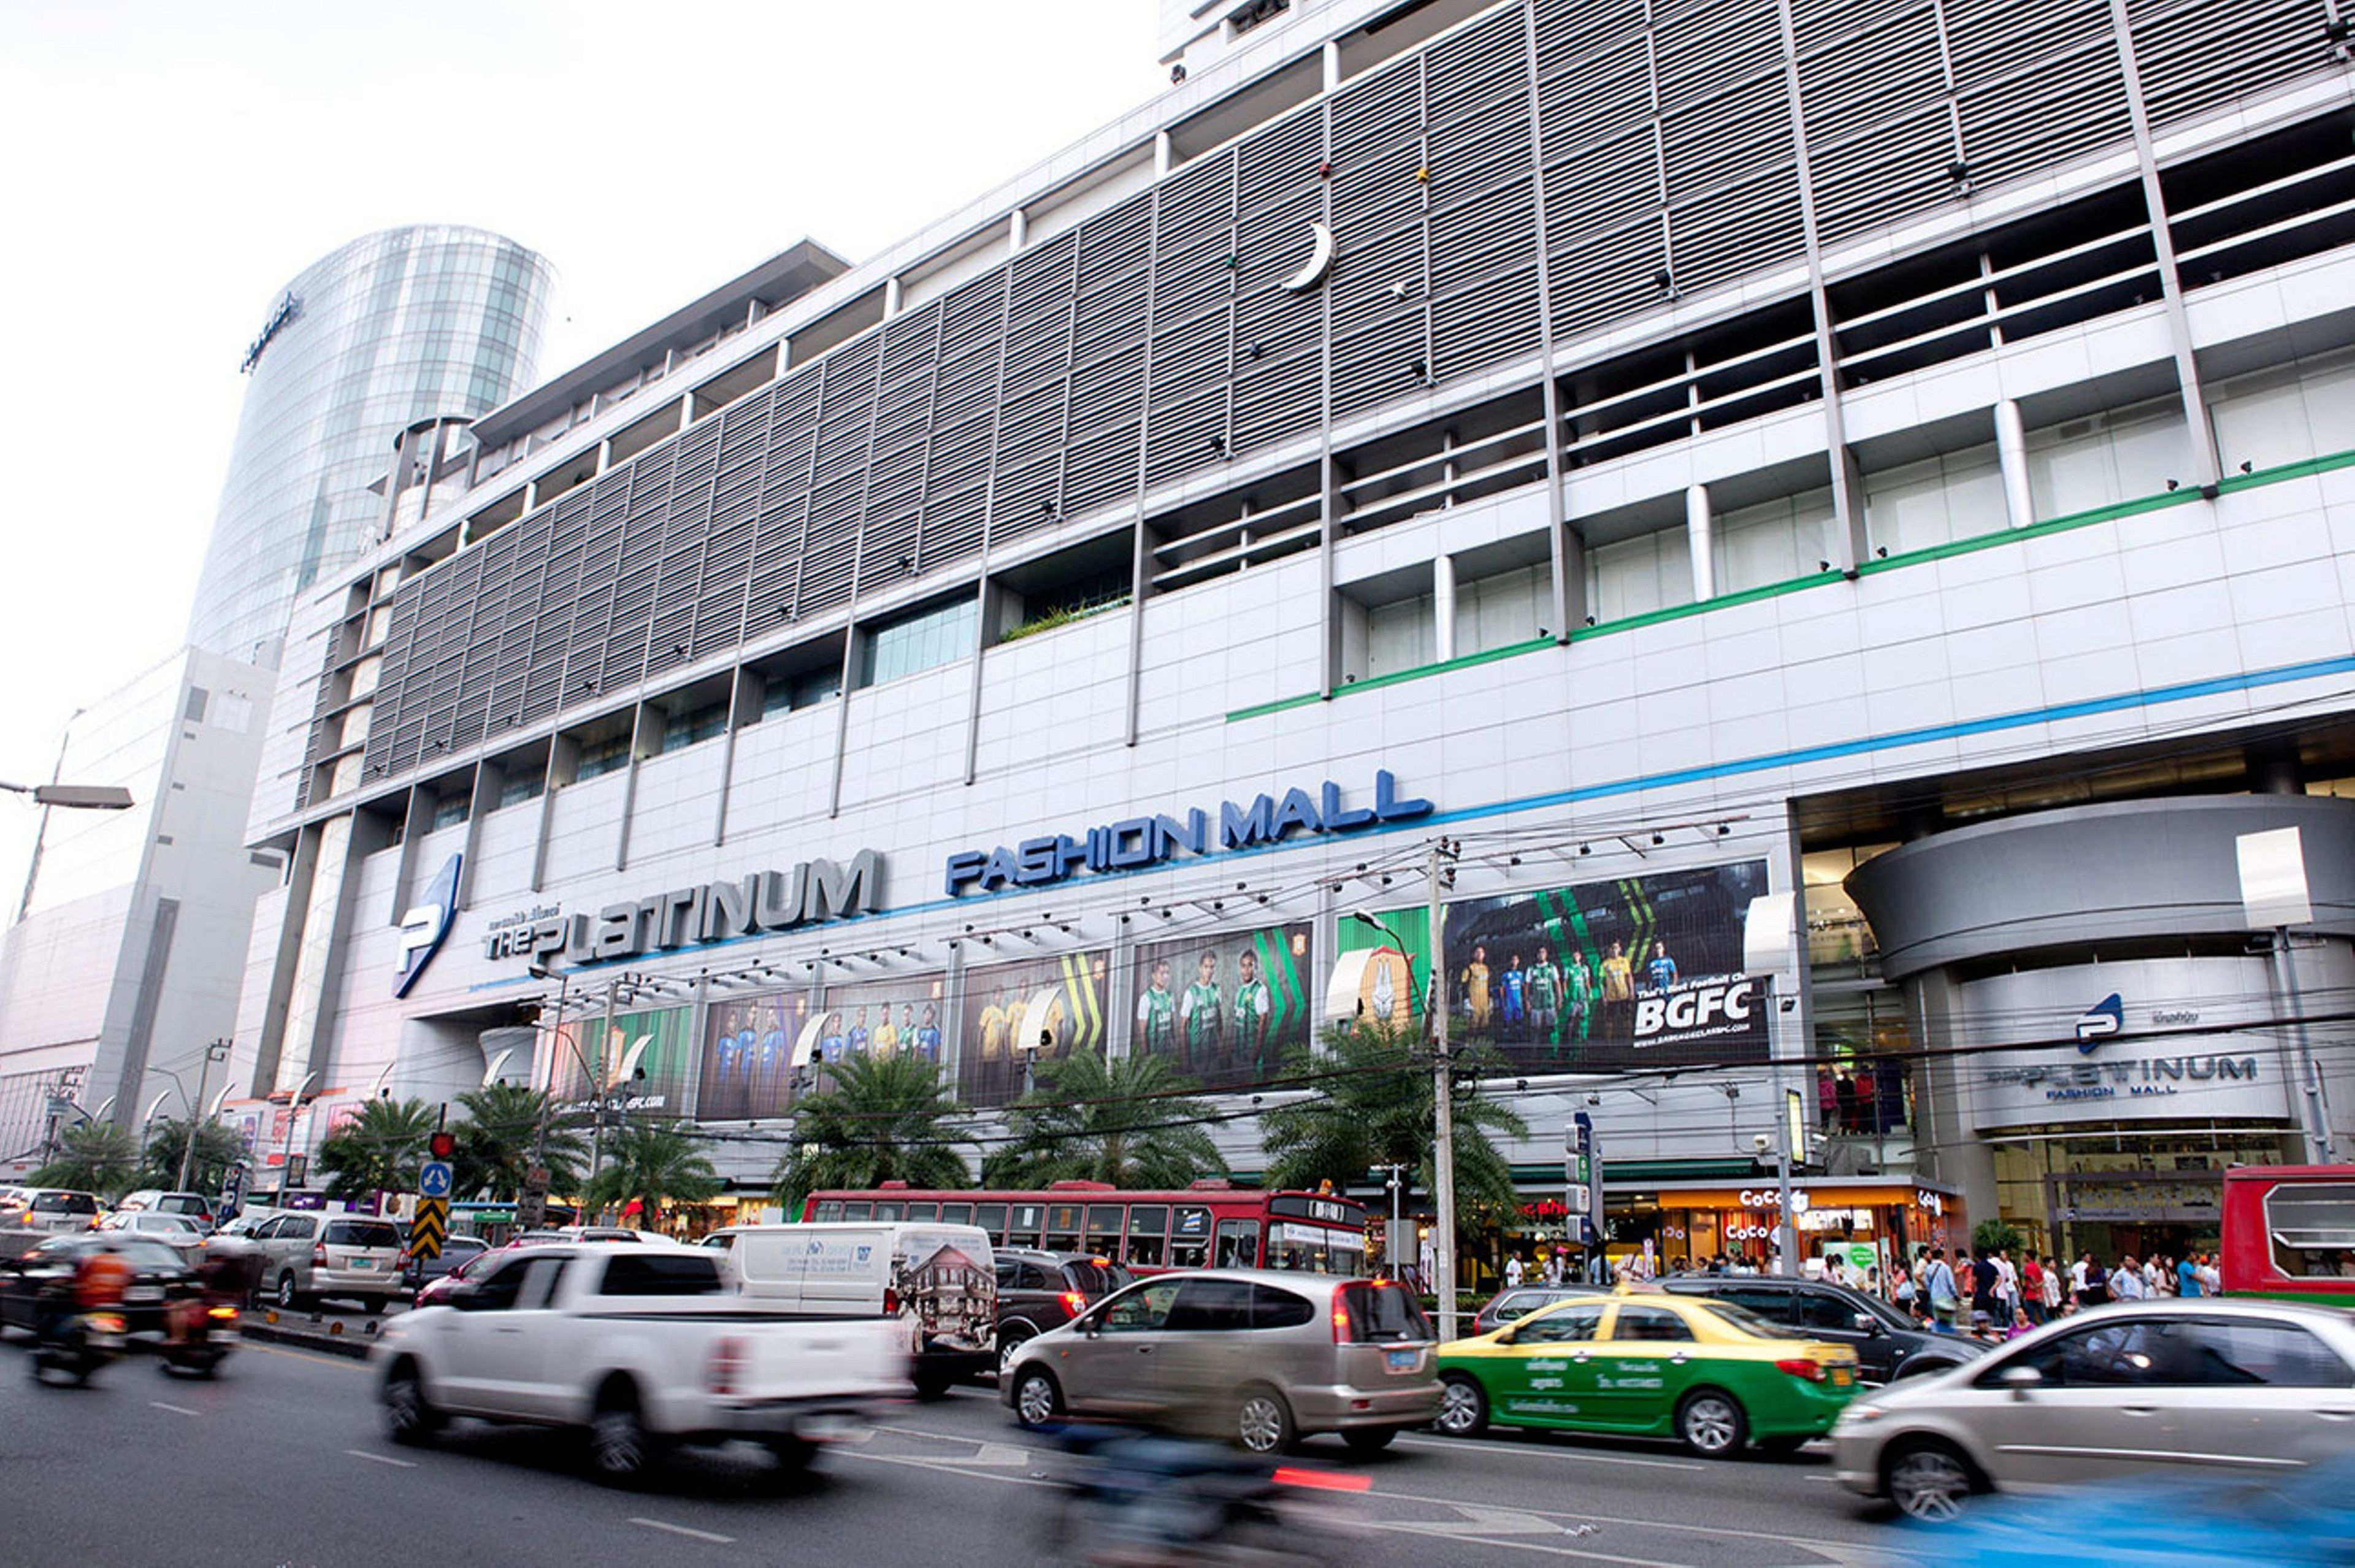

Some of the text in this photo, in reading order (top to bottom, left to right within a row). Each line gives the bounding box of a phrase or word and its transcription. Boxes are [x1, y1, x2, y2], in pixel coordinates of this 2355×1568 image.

[945, 769, 1434, 897] FASHION MALL
[1634, 982, 1752, 1036] BGFC
[2046, 1085, 2178, 1100] FASHION MALL
[1726, 1225, 1767, 1239] CoCo
